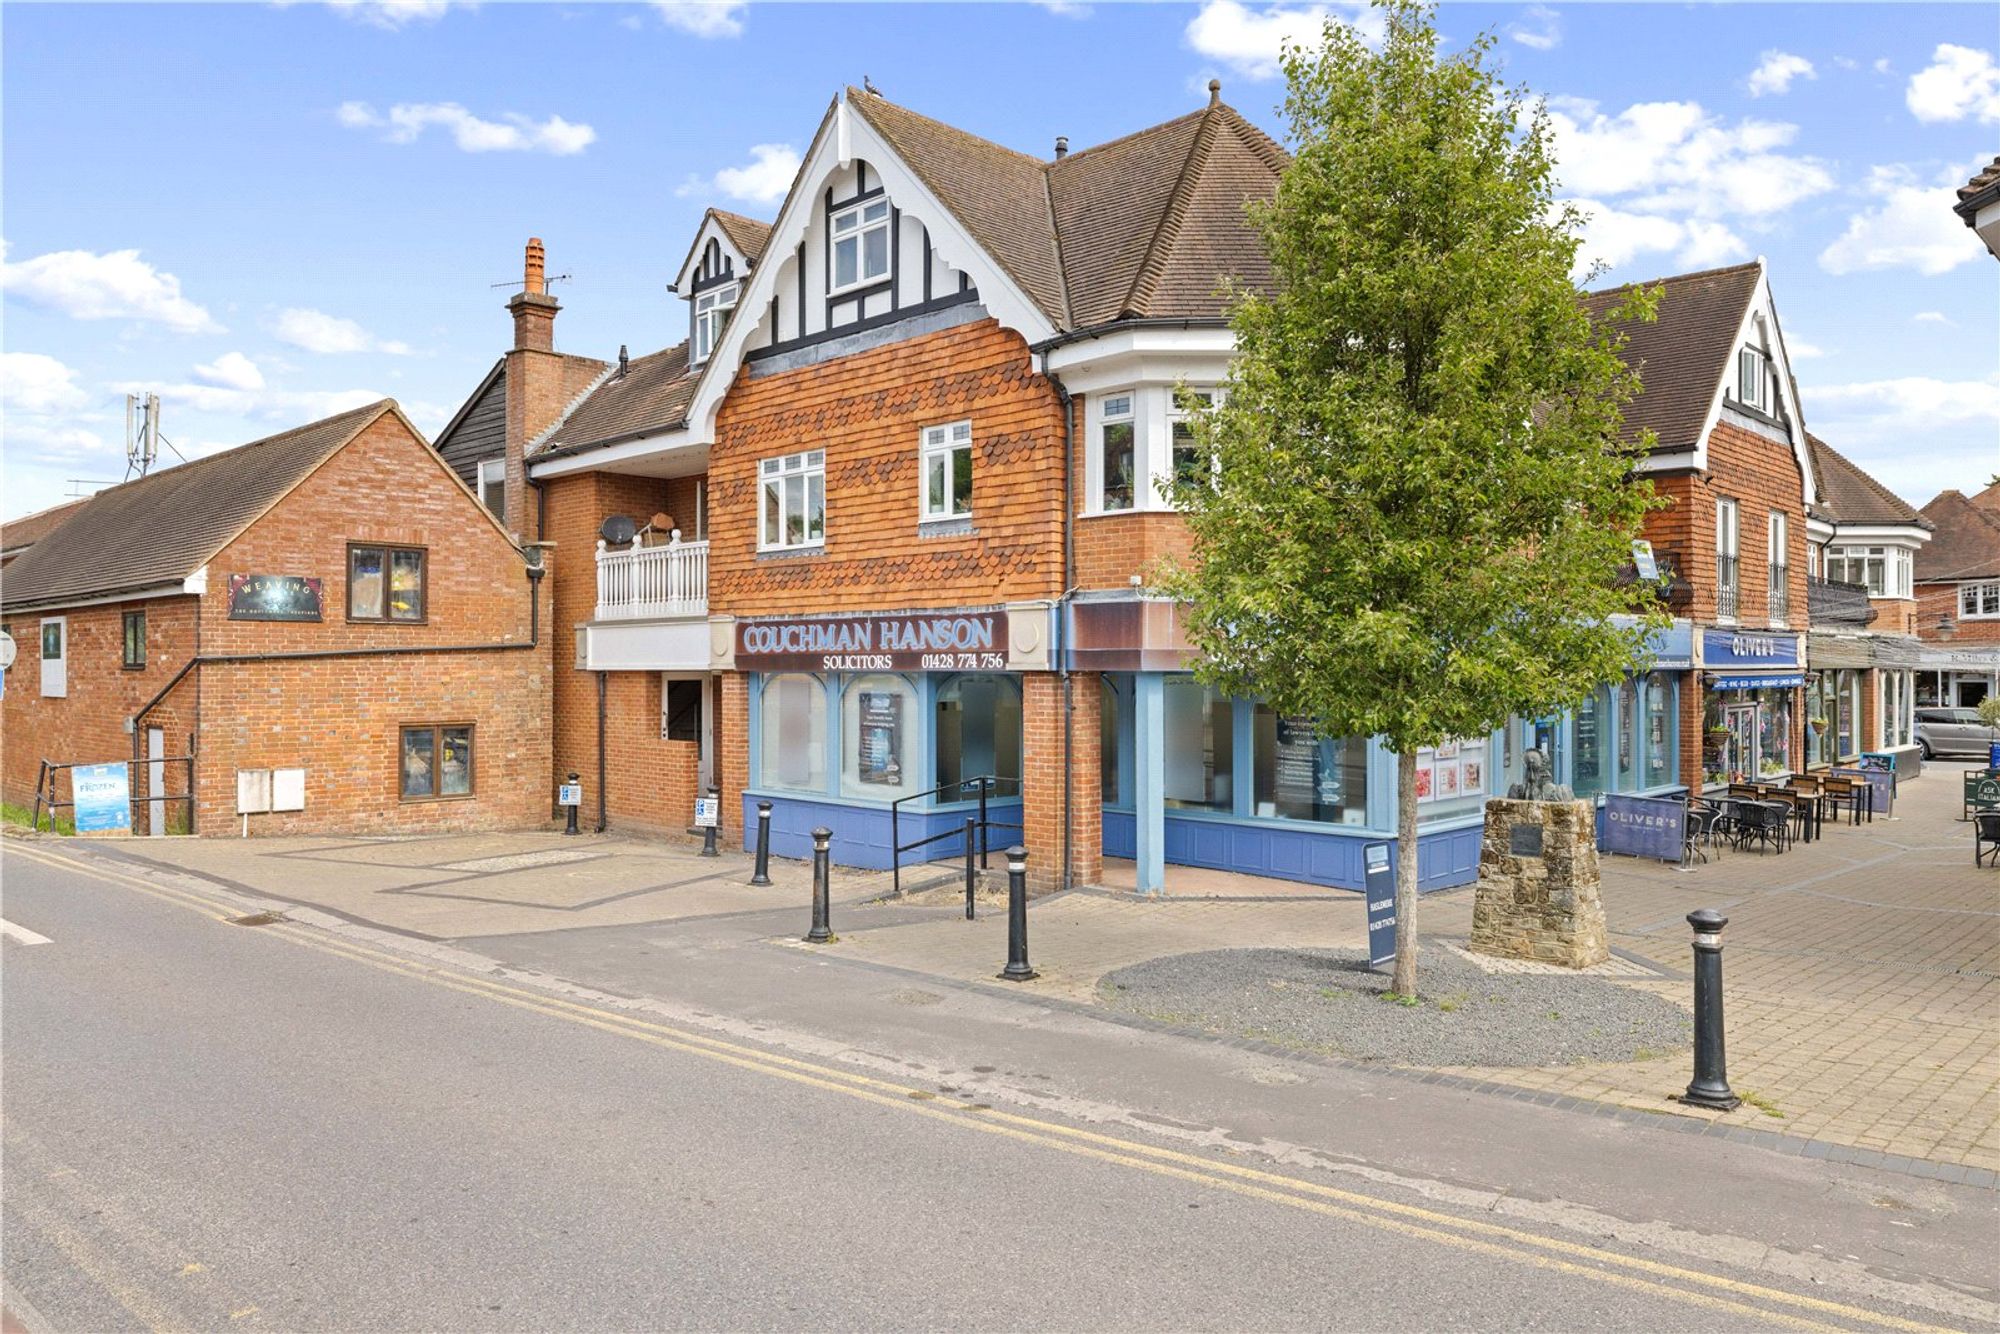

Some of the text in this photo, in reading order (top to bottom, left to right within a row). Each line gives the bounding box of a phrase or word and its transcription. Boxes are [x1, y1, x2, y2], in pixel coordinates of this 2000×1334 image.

[743, 617, 994, 653] COUCHMAN HANSON
[823, 652, 1004, 669] SOLICITORS 01428 774 756
[1609, 811, 1677, 829] OLIVER'S
